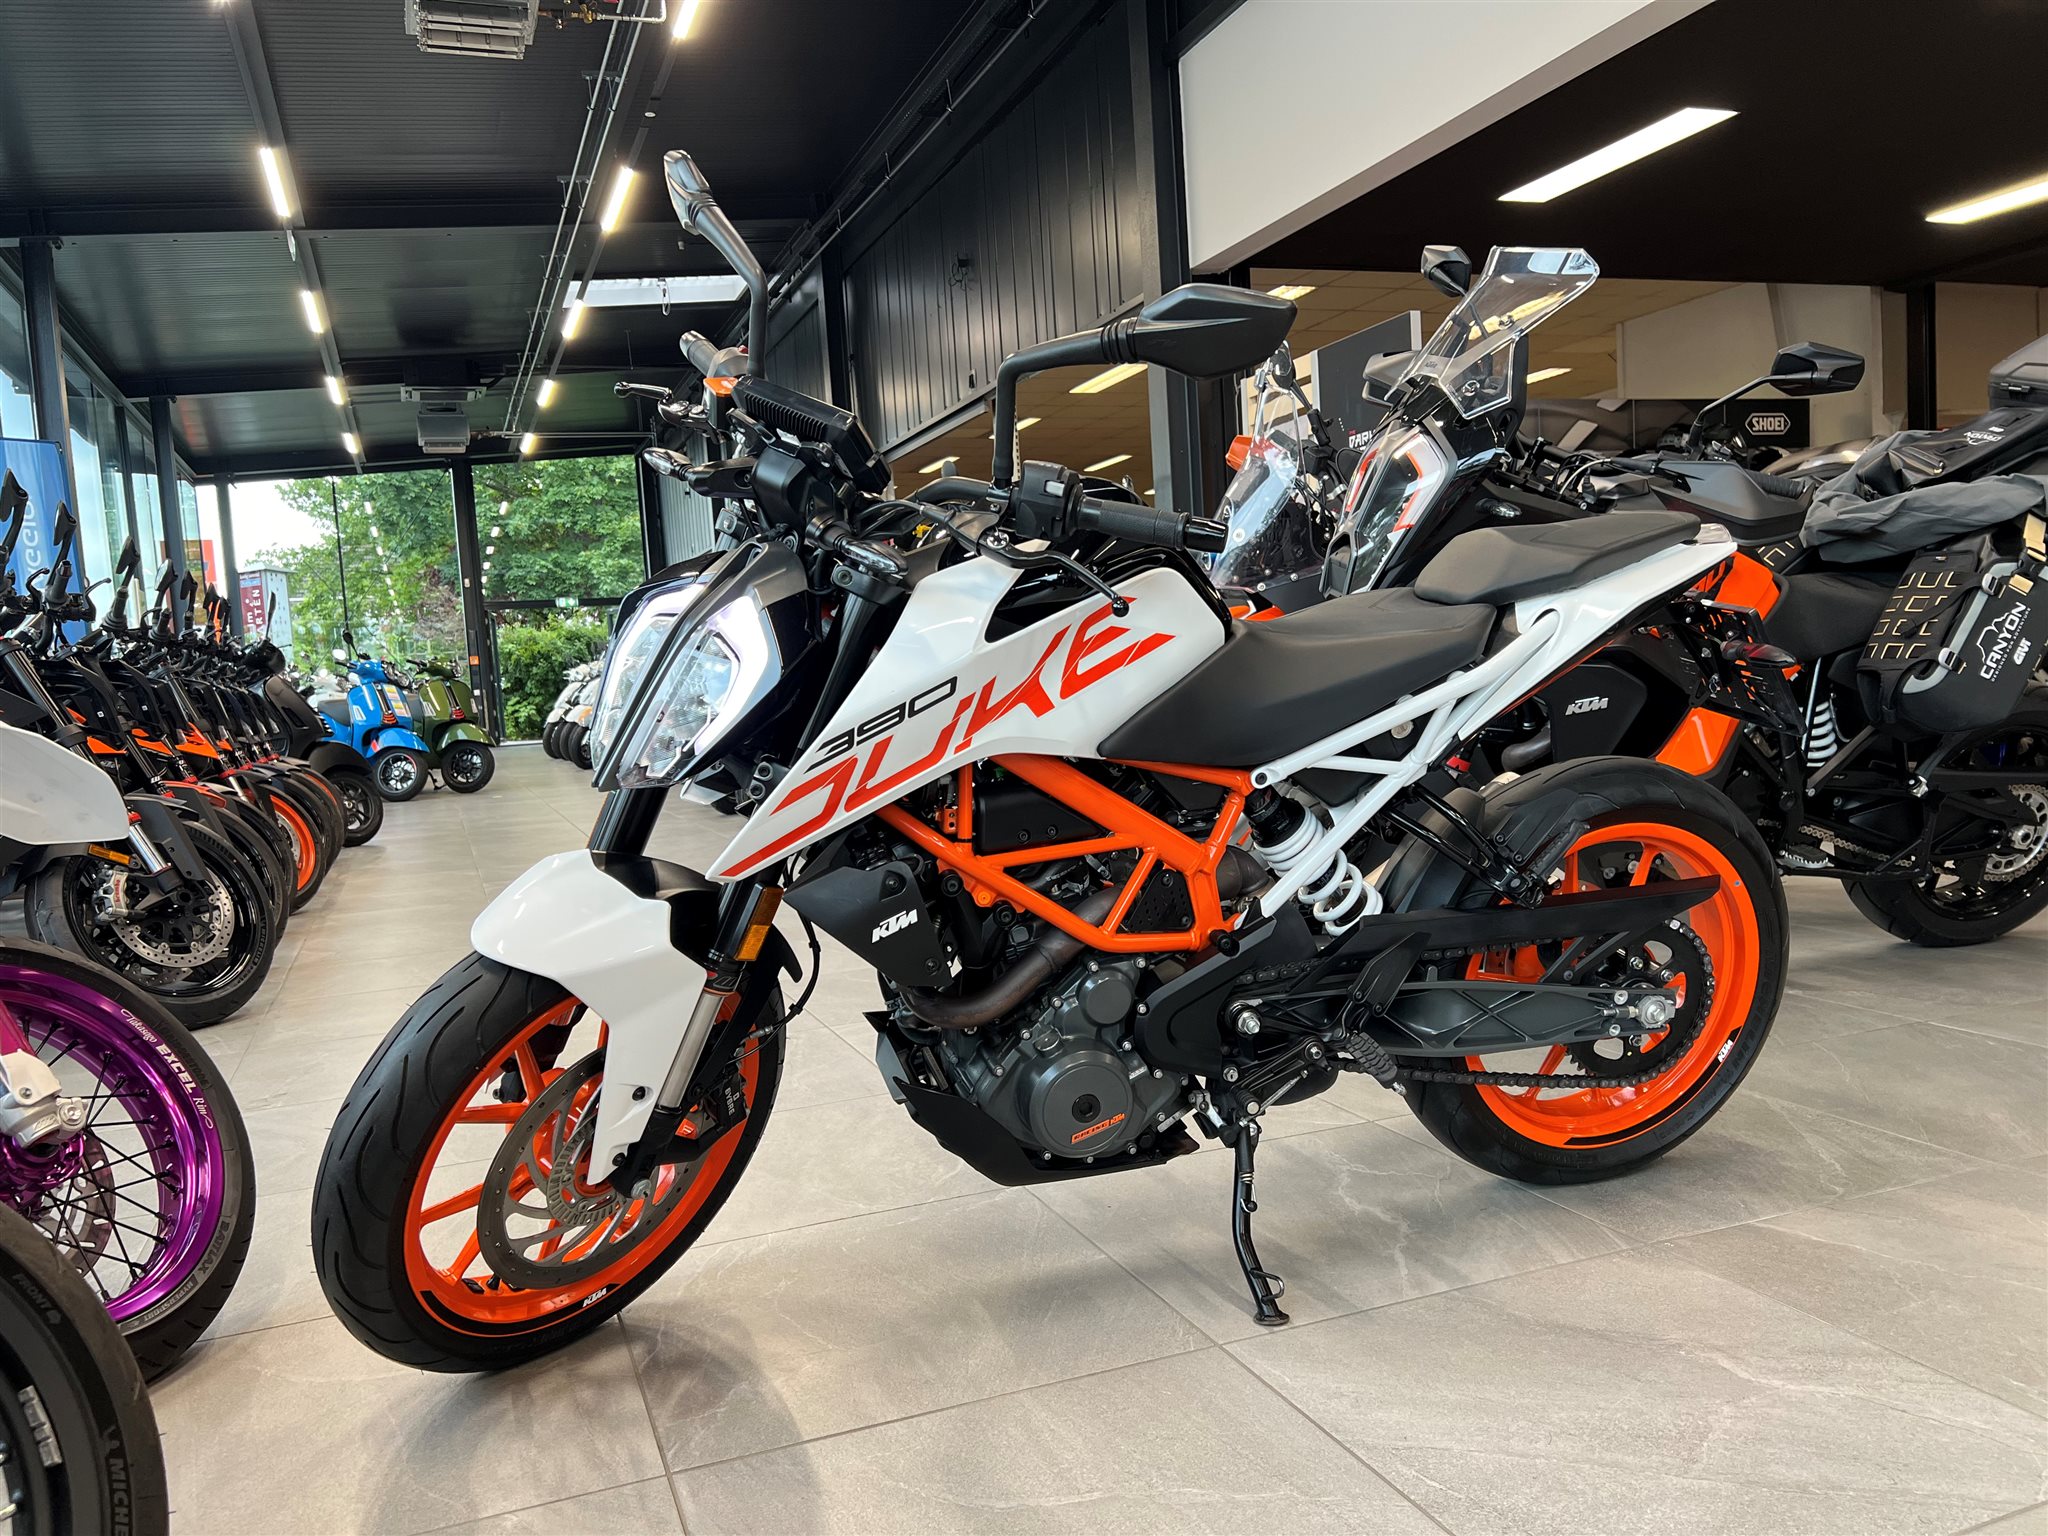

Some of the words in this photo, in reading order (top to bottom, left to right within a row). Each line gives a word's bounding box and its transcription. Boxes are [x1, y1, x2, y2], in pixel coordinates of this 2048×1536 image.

[1752, 417, 1785, 431] SHOEI
[1980, 602, 2026, 679] CANYON
[2014, 637, 2032, 665] GIVI
[1565, 696, 1609, 716] KTM
[719, 597, 1176, 877] DUKE
[803, 675, 958, 774] 390
[871, 908, 918, 943] KTM
[121, 1008, 157, 1043] Takasago
[155, 1043, 197, 1094] EXCEL
[192, 1097, 214, 1129] Rim
[1717, 1039, 1734, 1063] KTM
[724, 1087, 735, 1116] BYBRE
[198, 1221, 230, 1273] BATTLAX
[12, 1274, 52, 1309] FRONT
[143, 1281, 194, 1321] HYPERSPORT
[582, 1287, 607, 1308] KTM
